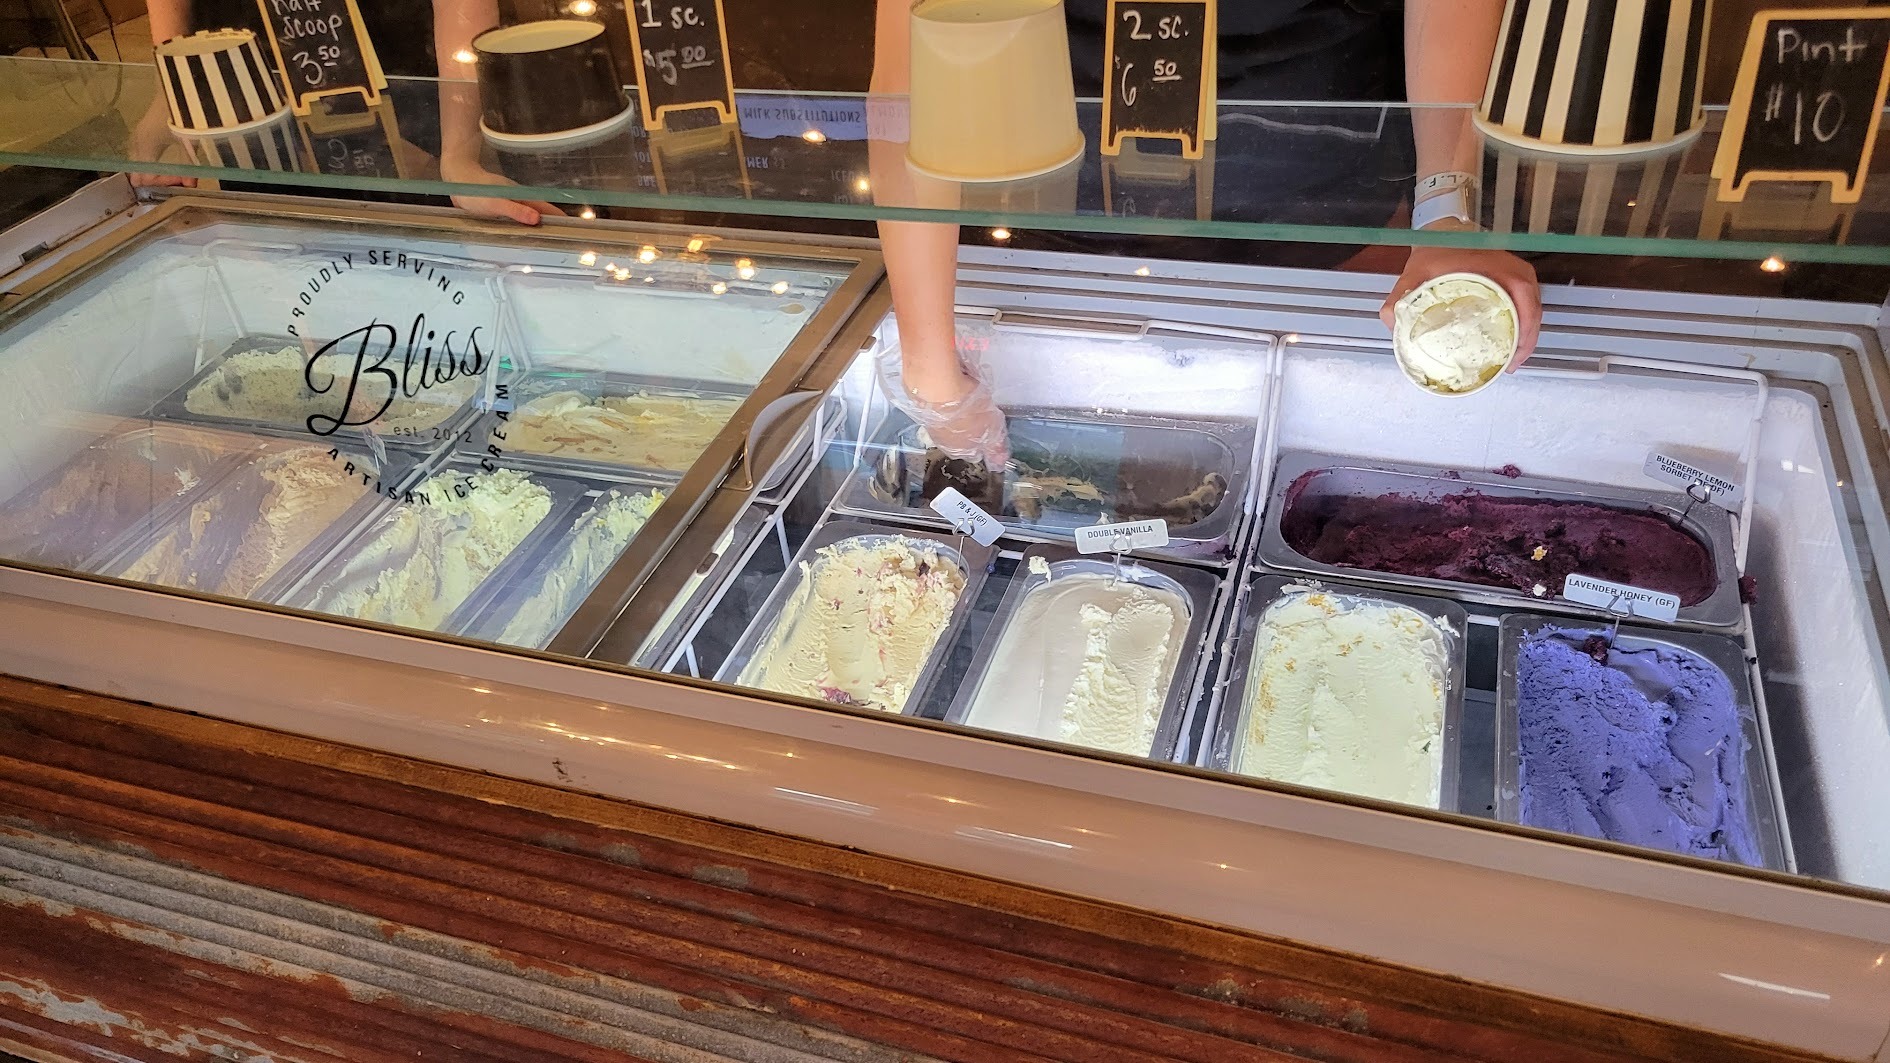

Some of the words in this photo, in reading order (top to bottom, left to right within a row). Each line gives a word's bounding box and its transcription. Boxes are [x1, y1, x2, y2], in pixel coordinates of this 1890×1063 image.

[641, 0, 662, 27] 1
[1122, 10, 1152, 40] 2
[1777, 26, 1868, 64] Pint
[286, 252, 354, 337] PROUDLY
[368, 249, 465, 306] SERVING
[304, 312, 495, 437] Bliss
[327, 447, 431, 506] ARTISAN
[444, 475, 479, 503] ICE
[480, 383, 510, 473] CREAM
[1655, 454, 1705, 478] BLUEBERRY
[1704, 474, 1735, 492] LEMON
[1660, 464, 1693, 481] SORBET
[1087, 528, 1120, 539] DOUBLE
[1119, 525, 1154, 536] VANILLA
[1568, 578, 1618, 595] LAVENDER
[1619, 590, 1654, 603] HONEY
[1655, 597, 1676, 610] (GF)
